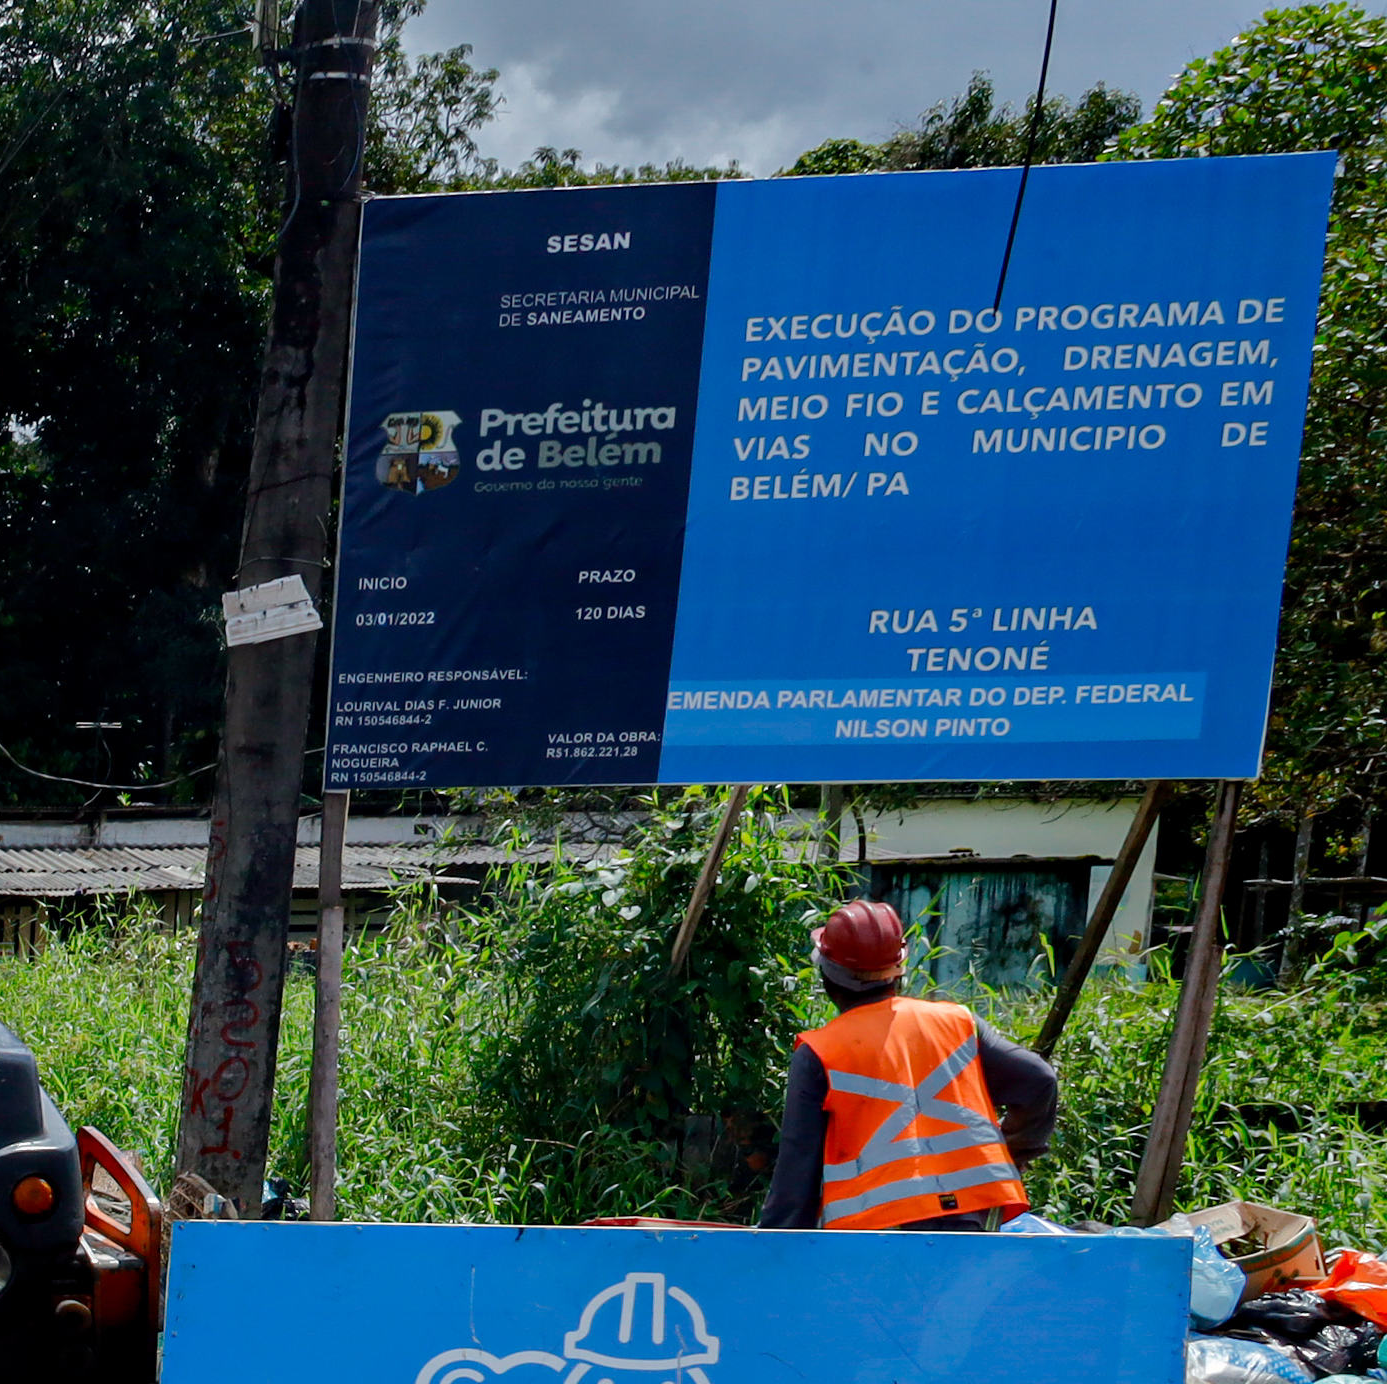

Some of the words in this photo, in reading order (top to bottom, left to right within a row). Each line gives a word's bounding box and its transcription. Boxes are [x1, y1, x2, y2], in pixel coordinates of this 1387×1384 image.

[546, 231, 631, 254] SESAN
[500, 290, 606, 309] SECRETARIA
[610, 285, 700, 303] MUNICIPAL
[499, 313, 522, 327] DE
[526, 306, 646, 326] SANEAMENTO
[744, 305, 936, 345] EXECUÇÃO
[948, 308, 1003, 334] DO
[1014, 300, 1225, 332] PROGRAMA
[1237, 297, 1286, 325] DE
[741, 343, 1027, 382] PAVIMENTAÇÃO,
[1063, 339, 1279, 372] DRENAGEM,
[737, 393, 829, 422] MEIO
[845, 391, 903, 418] FIO
[921, 390, 940, 416] E
[956, 382, 1203, 420] CALÇAMENTO
[1219, 380, 1274, 407] EM
[480, 398, 676, 437] Prefeitura
[476, 441, 526, 472] de
[537, 428, 661, 469] Belém
[734, 434, 810, 461] VIAS
[864, 431, 919, 457] NO
[972, 424, 1167, 454] MUNICIPIO
[1221, 421, 1269, 447] DE
[730, 468, 858, 501] BELÉM/
[866, 471, 910, 496] PA
[358, 576, 407, 590] INICIO
[578, 569, 636, 584] PRAZO
[355, 612, 435, 627] 03/01/2022
[575, 606, 602, 620] 120
[607, 606, 646, 620] DIAS
[868, 609, 938, 635] RUA
[993, 606, 1098, 632] LINHA
[907, 640, 1050, 673] TENONÉ
[338, 671, 424, 684] ENGENHEIRO
[427, 667, 528, 682] RESPONSÁVEL:
[336, 700, 401, 713] LOURIVAL
[404, 700, 436, 711] DIAS
[438, 699, 450, 711] F.
[453, 697, 501, 710] JUNIOR
[667, 690, 771, 711] EMENDA
[776, 687, 962, 709] PARLAMENTAR
[967, 687, 1007, 707] DO
[1012, 686, 1067, 706] DEP.
[1075, 683, 1194, 704] FEDERAL
[335, 716, 353, 727] RN
[357, 714, 432, 726] 150546844-2
[834, 718, 928, 739] NILSON
[935, 717, 1010, 738] PINTO
[332, 743, 408, 755] FRANCISCO
[411, 741, 473, 753] RAPHAEL
[476, 741, 488, 752] C.
[547, 732, 593, 744] VALOR
[597, 732, 614, 743] DA
[618, 731, 661, 743] OBRA:
[331, 757, 399, 769] NOGUEIRA
[331, 772, 349, 783] RN
